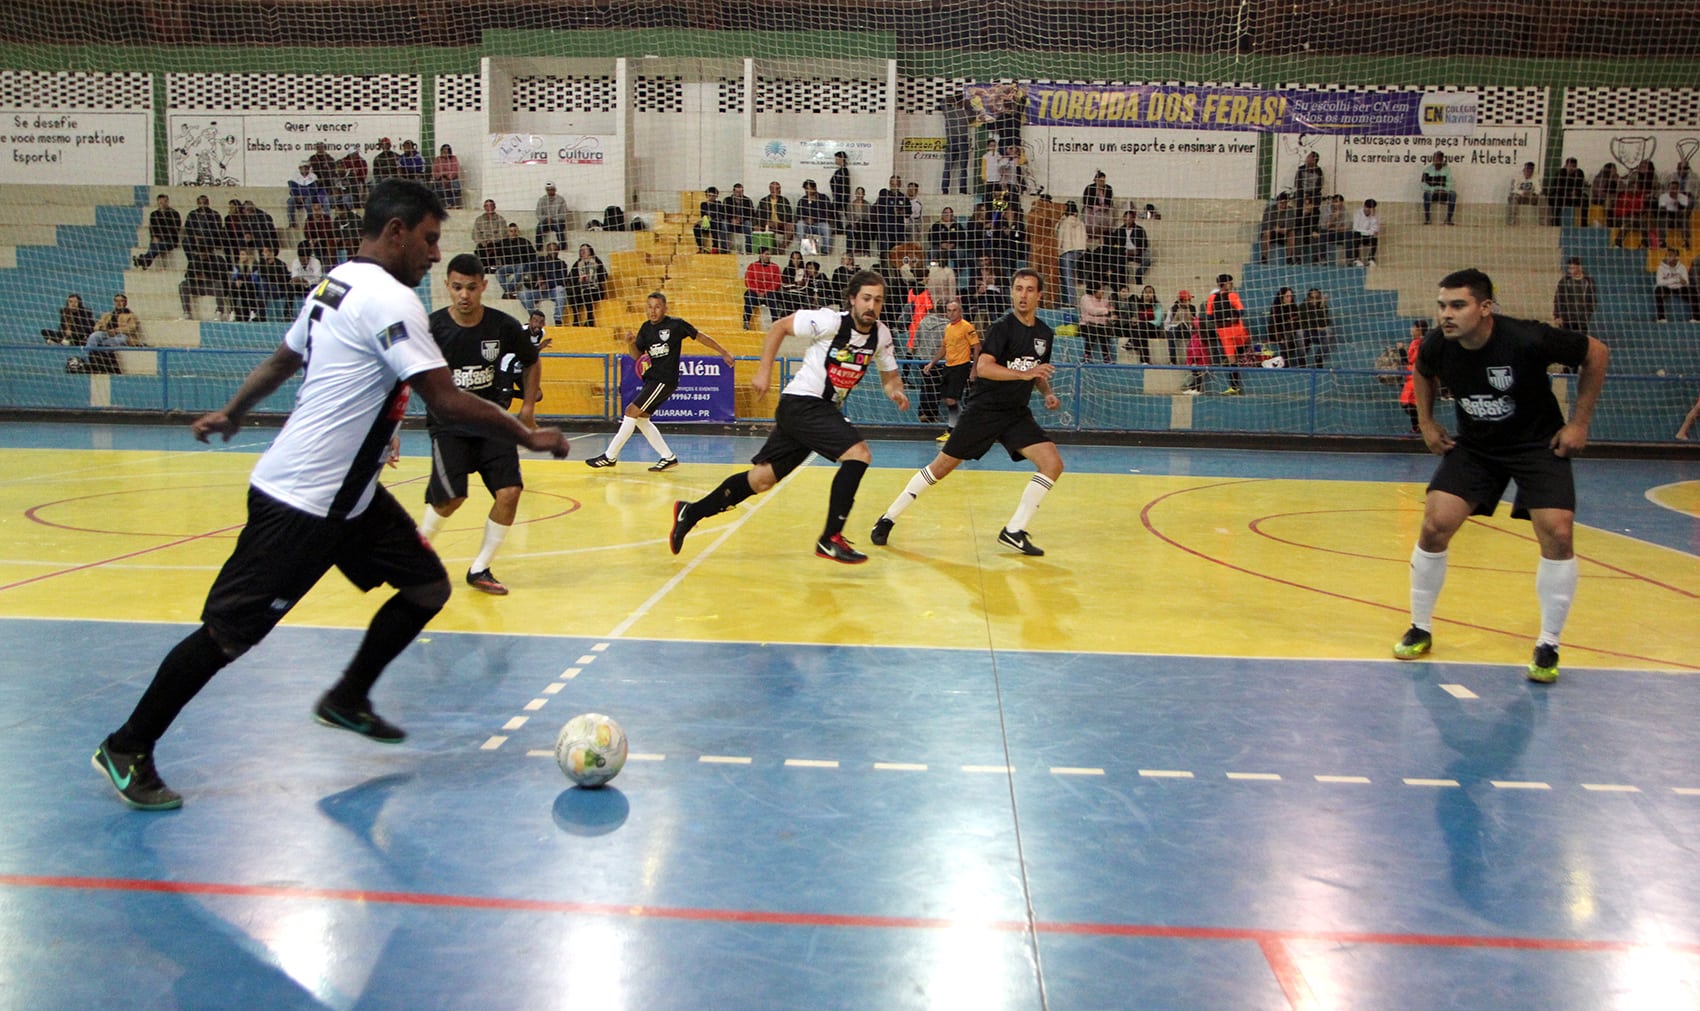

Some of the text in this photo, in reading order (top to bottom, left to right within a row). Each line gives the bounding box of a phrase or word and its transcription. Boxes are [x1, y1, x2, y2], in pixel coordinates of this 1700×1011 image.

[1037, 89, 1287, 126] TORCIDA DOS FERAS!
[1295, 100, 1409, 112] Eu escolhi ser CN em
[1292, 112, 1404, 124] todos os momentos!
[1424, 106, 1444, 122] CN
[14, 115, 29, 128] Se
[284, 121, 359, 132] Quer vencer?
[38, 135, 71, 143] mesmo
[76, 129, 125, 147] pratique
[274, 138, 293, 152] faça
[295, 143, 301, 151] o
[1052, 136, 1094, 152] Ensinar
[1099, 143, 1117, 152] um
[1120, 137, 1166, 154] esporte
[1178, 137, 1217, 152] ensinar
[1218, 144, 1225, 152] a
[1228, 137, 1255, 153] viver
[1343, 135, 1350, 145] A
[1413, 137, 1432, 145] uma
[1435, 137, 1459, 149] peça
[13, 149, 63, 165] Esporte!
[558, 148, 604, 160] Cultura
[1345, 149, 1358, 163] Na
[1361, 149, 1401, 163] carreira
[1403, 149, 1417, 163] de
[1471, 149, 1517, 165] Atleta!
[679, 360, 720, 376] Além
[699, 409, 710, 417] PR
